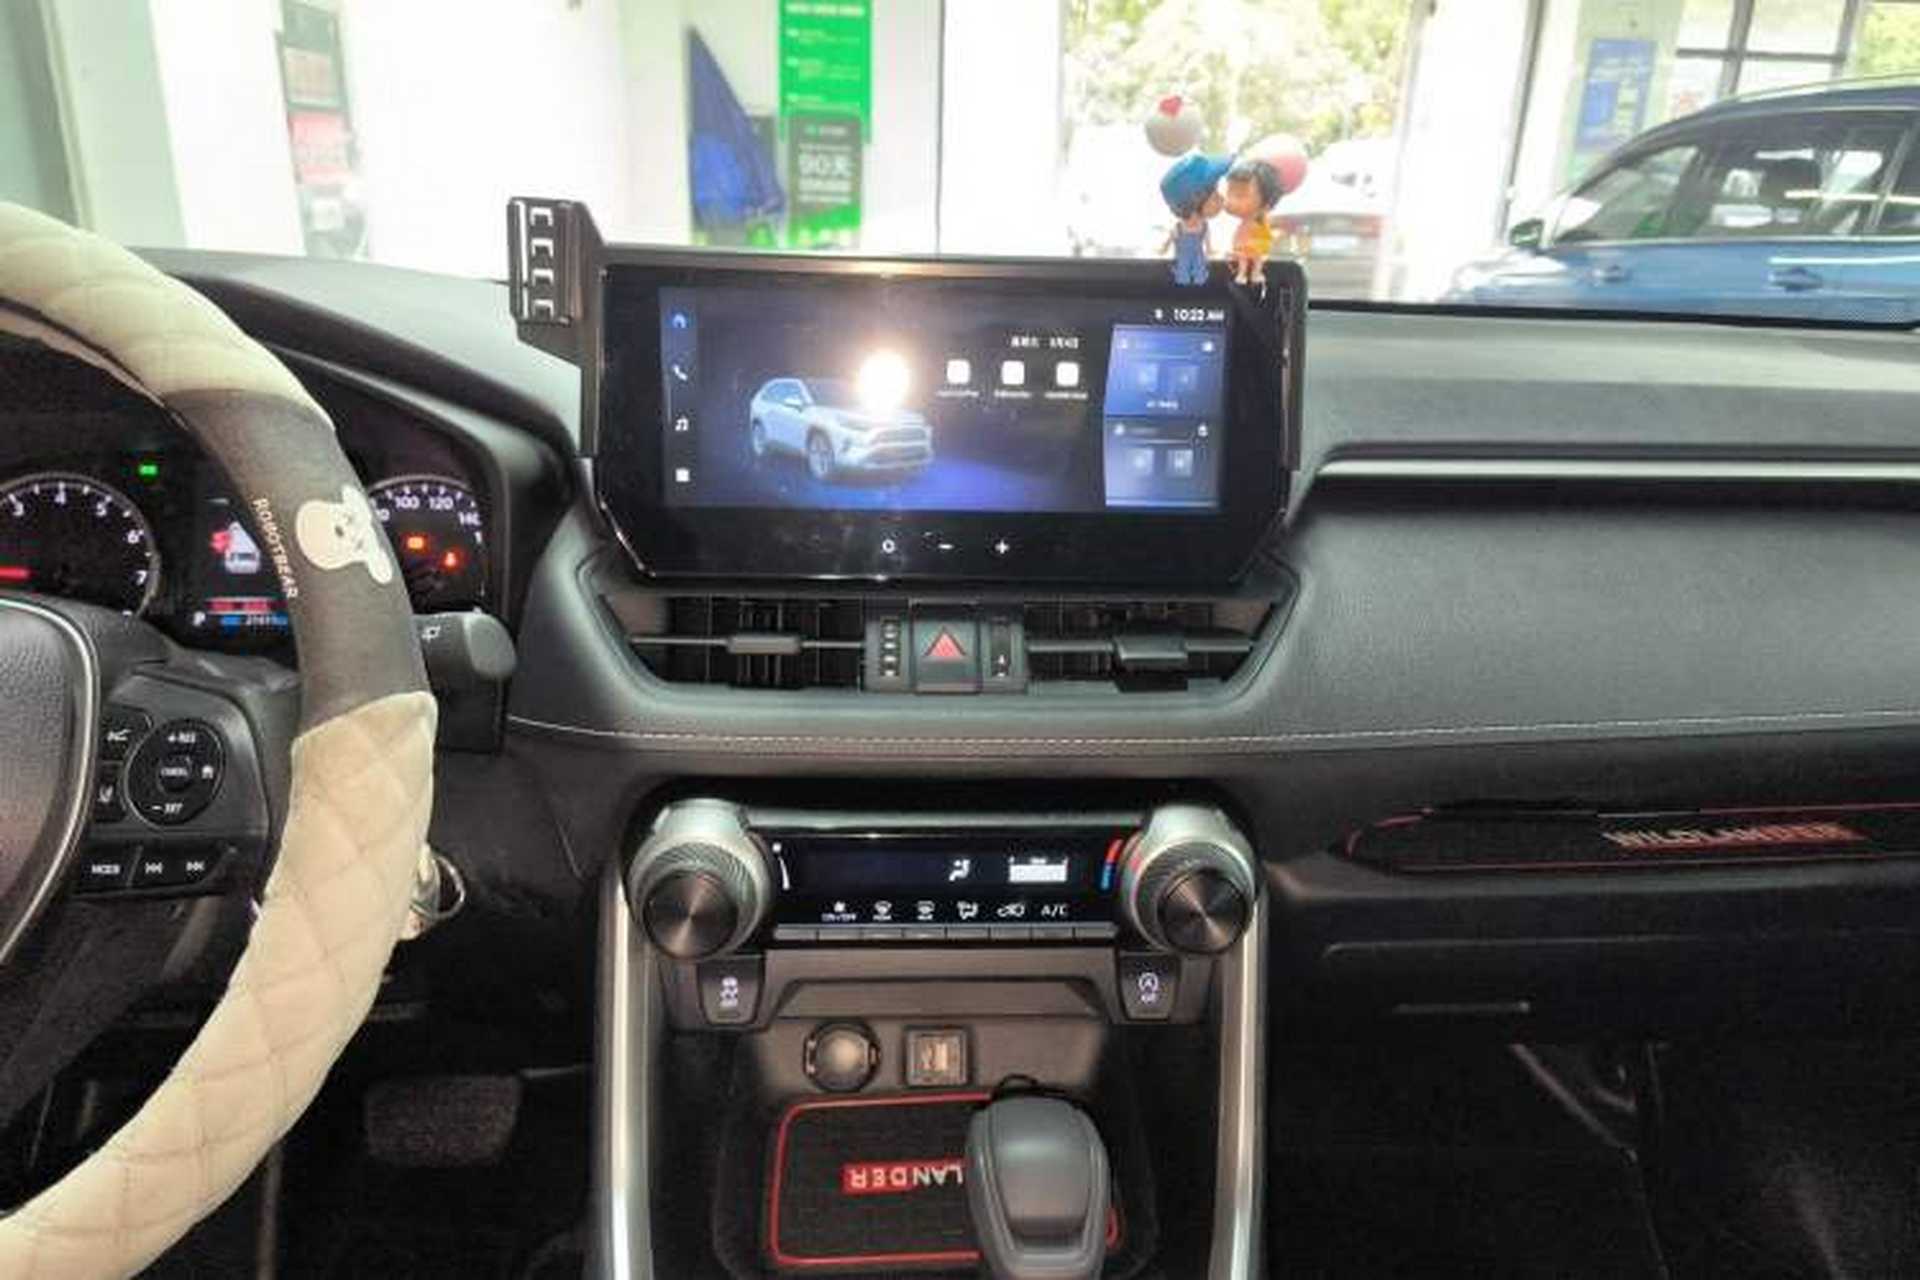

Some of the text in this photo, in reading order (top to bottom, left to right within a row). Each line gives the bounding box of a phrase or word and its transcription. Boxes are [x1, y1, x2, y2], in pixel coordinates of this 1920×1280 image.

[96, 503, 107, 516] 5
[395, 496, 420, 510] 100
[429, 497, 454, 510] 120
[375, 508, 391, 521] 0
[127, 530, 139, 544] 6
[136, 570, 147, 585] 7
